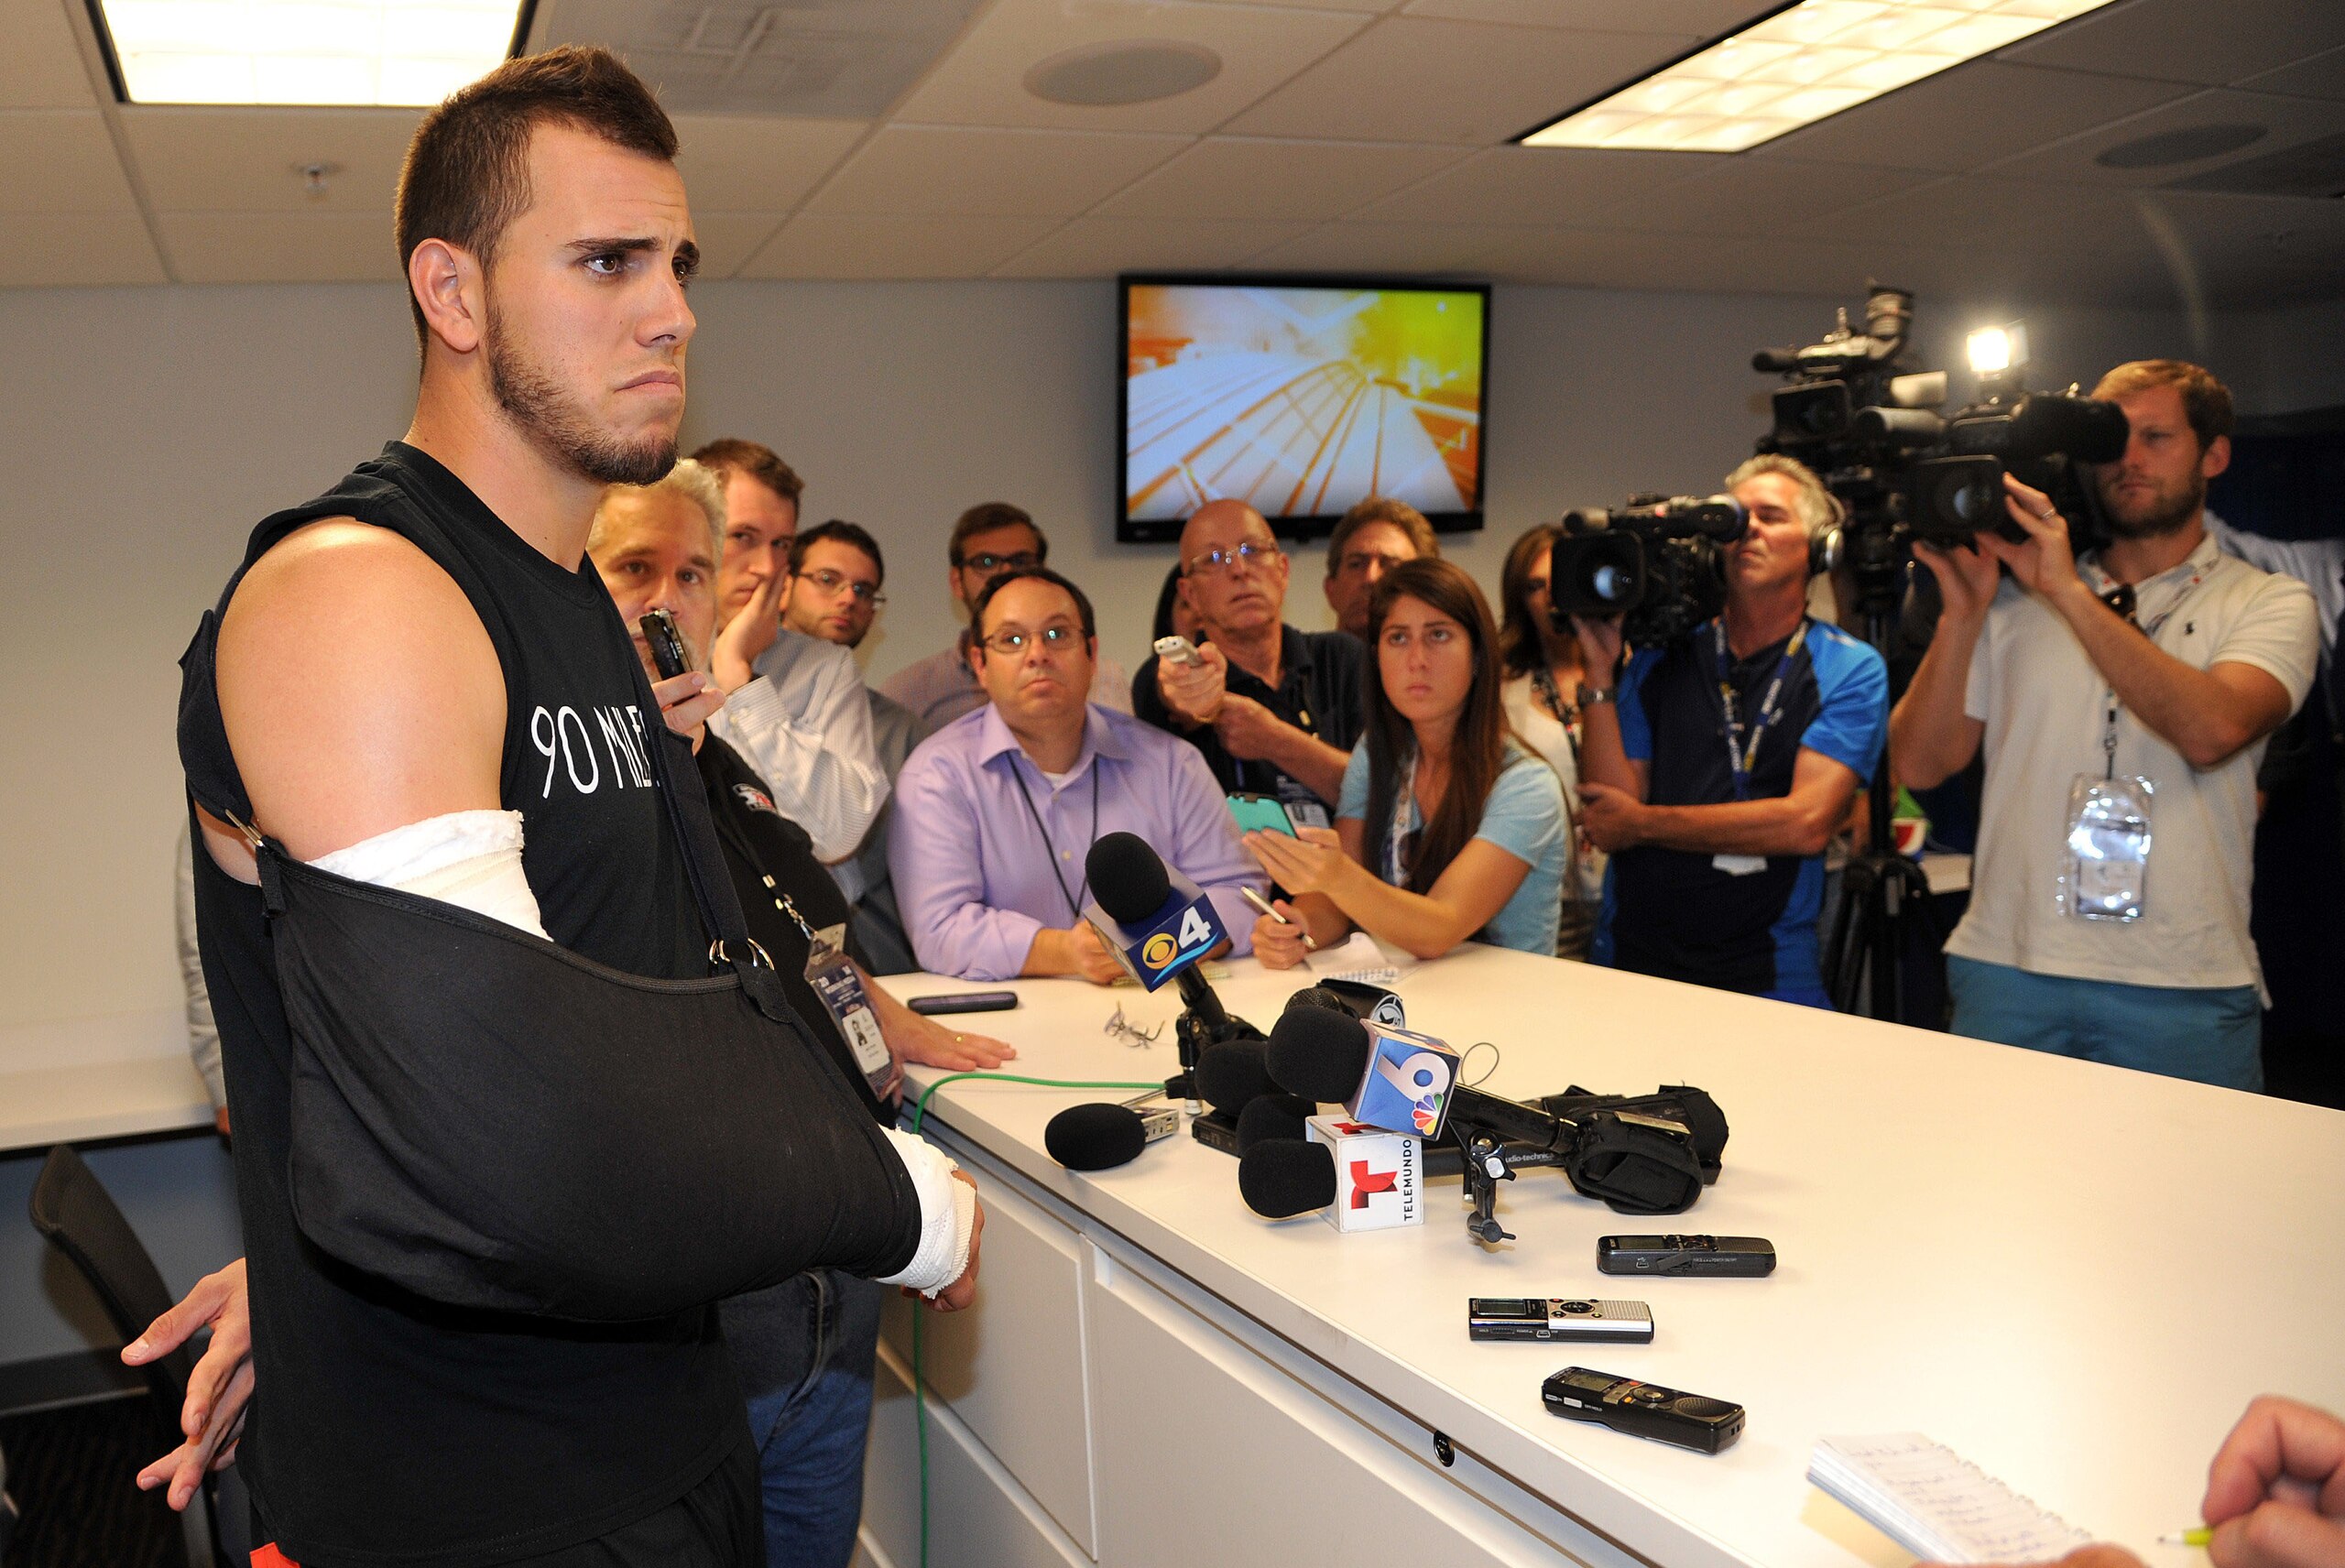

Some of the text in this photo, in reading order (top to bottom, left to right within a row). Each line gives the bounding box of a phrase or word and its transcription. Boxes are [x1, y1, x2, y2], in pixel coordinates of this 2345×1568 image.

[530, 705, 599, 800] 90
[1178, 906, 1212, 949] 4
[1376, 1051, 1451, 1103] 6
[1402, 1138, 1413, 1222] TELEMUNDO
